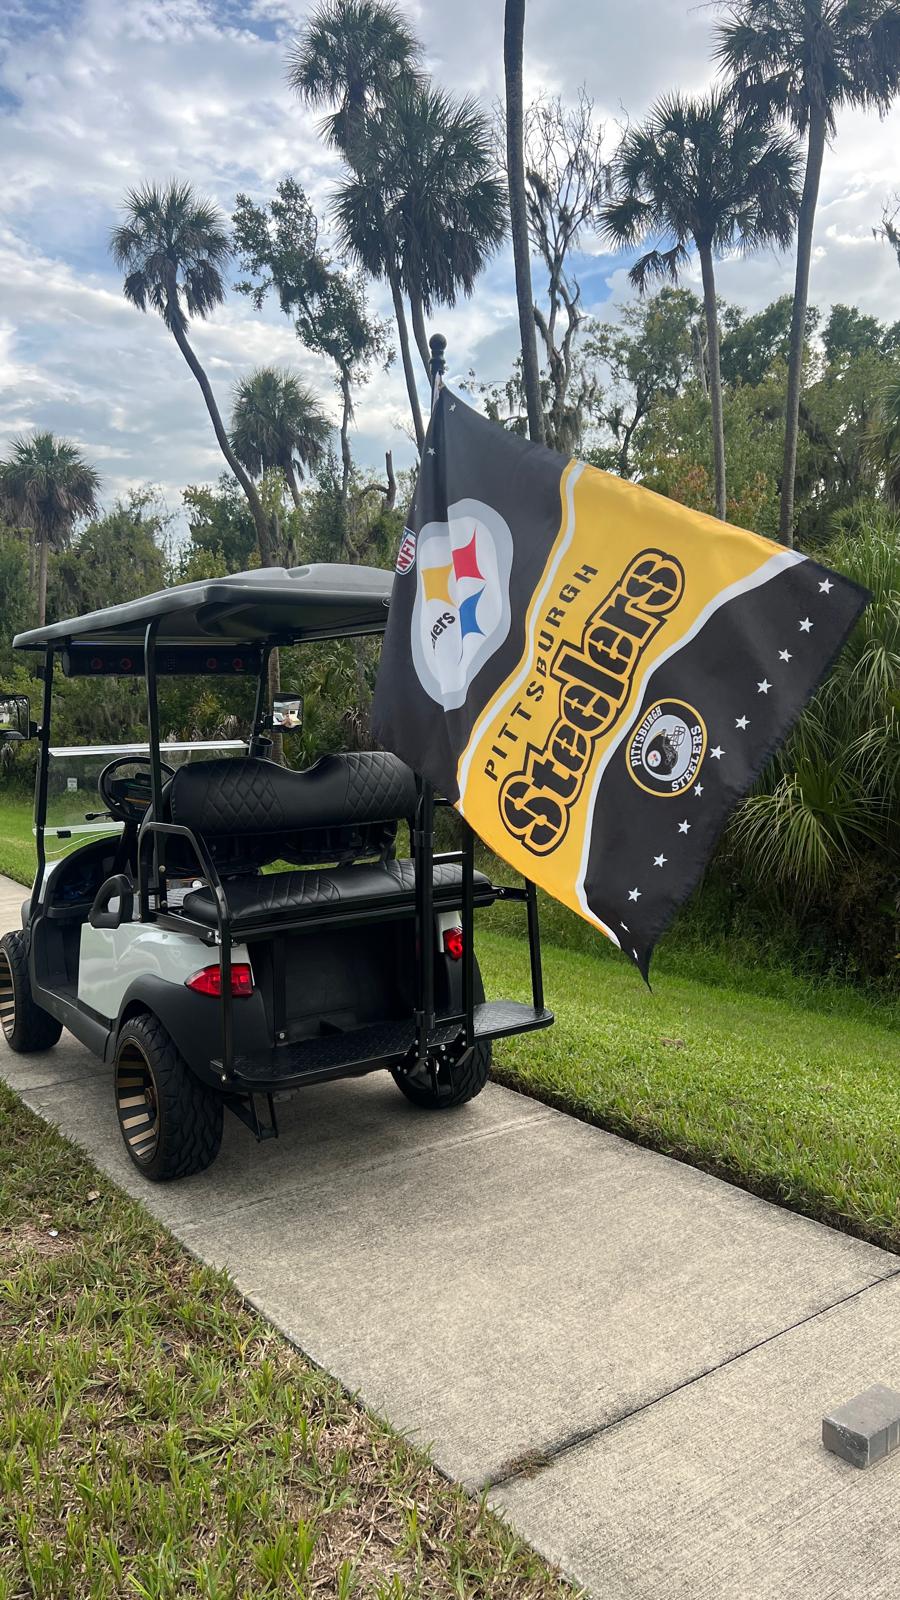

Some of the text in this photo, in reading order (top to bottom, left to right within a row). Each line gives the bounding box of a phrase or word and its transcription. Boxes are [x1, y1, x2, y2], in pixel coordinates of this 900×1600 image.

[431, 612, 456, 650] lers
[484, 564, 599, 782] PITTSBURGH
[499, 548, 686, 857] Steelers
[631, 705, 663, 767] PITTSBURGH
[671, 725, 703, 792] STEELERS
